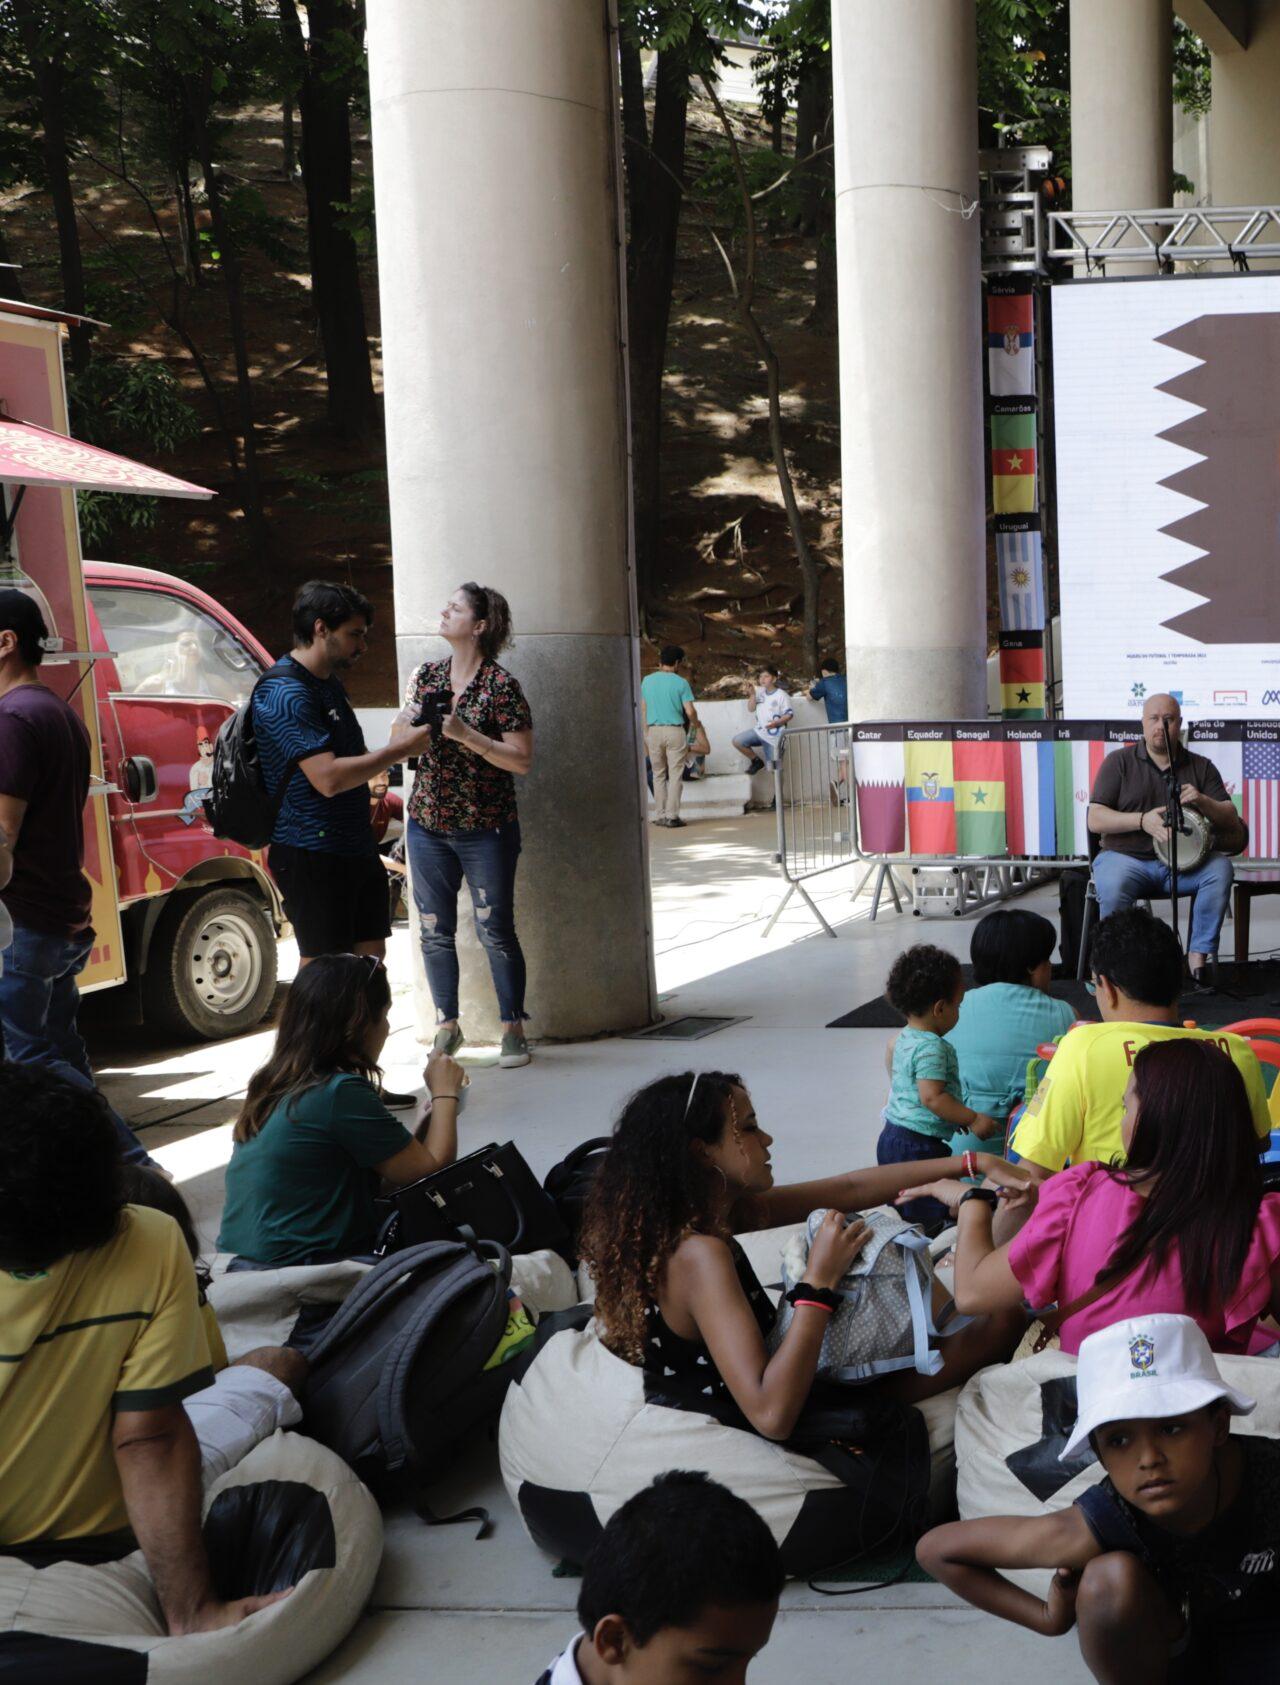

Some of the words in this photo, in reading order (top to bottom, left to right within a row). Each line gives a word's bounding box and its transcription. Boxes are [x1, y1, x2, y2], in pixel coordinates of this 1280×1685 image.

[994, 404, 1031, 413] Camarões
[999, 522, 1029, 531] Uruguai
[1213, 720, 1225, 728] de
[907, 730, 943, 740] Equador
[956, 730, 990, 740] Senegal
[1007, 730, 1042, 739] Holanda
[1058, 729, 1070, 738] Irã
[1110, 731, 1144, 741] Inglater
[1193, 730, 1218, 739] Gales
[1247, 730, 1278, 739] Unidos
[1130, 1370, 1159, 1379] BRASIL
